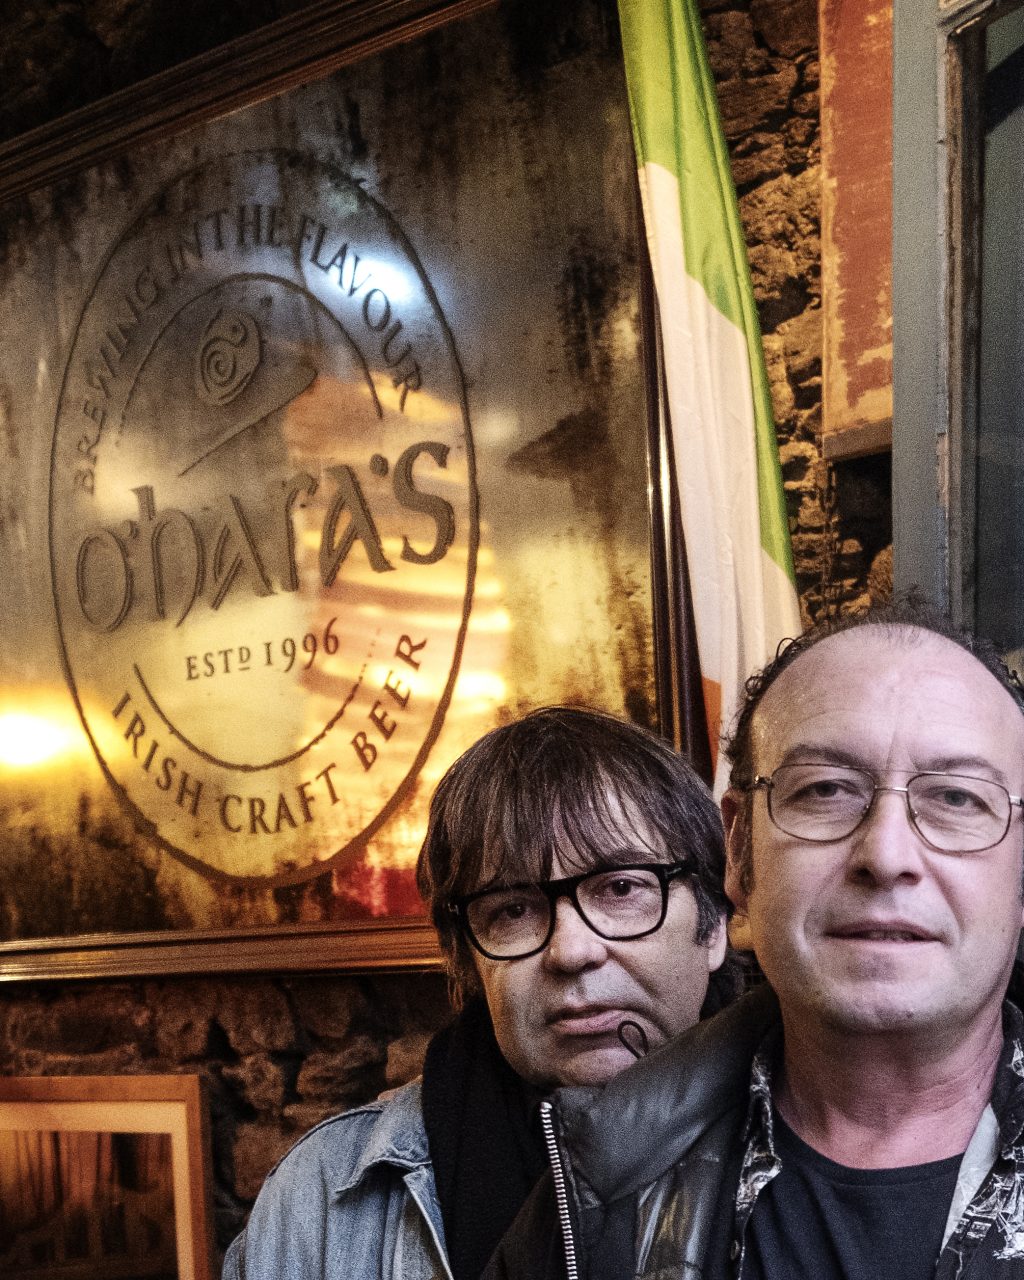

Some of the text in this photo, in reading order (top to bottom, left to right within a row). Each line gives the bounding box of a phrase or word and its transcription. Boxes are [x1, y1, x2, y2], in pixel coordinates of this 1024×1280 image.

[72, 204, 421, 496] BREWING IN THE FLAVOUR
[112, 633, 427, 835] IRISH CRAFT BEER
[264, 617, 339, 674] 1996
